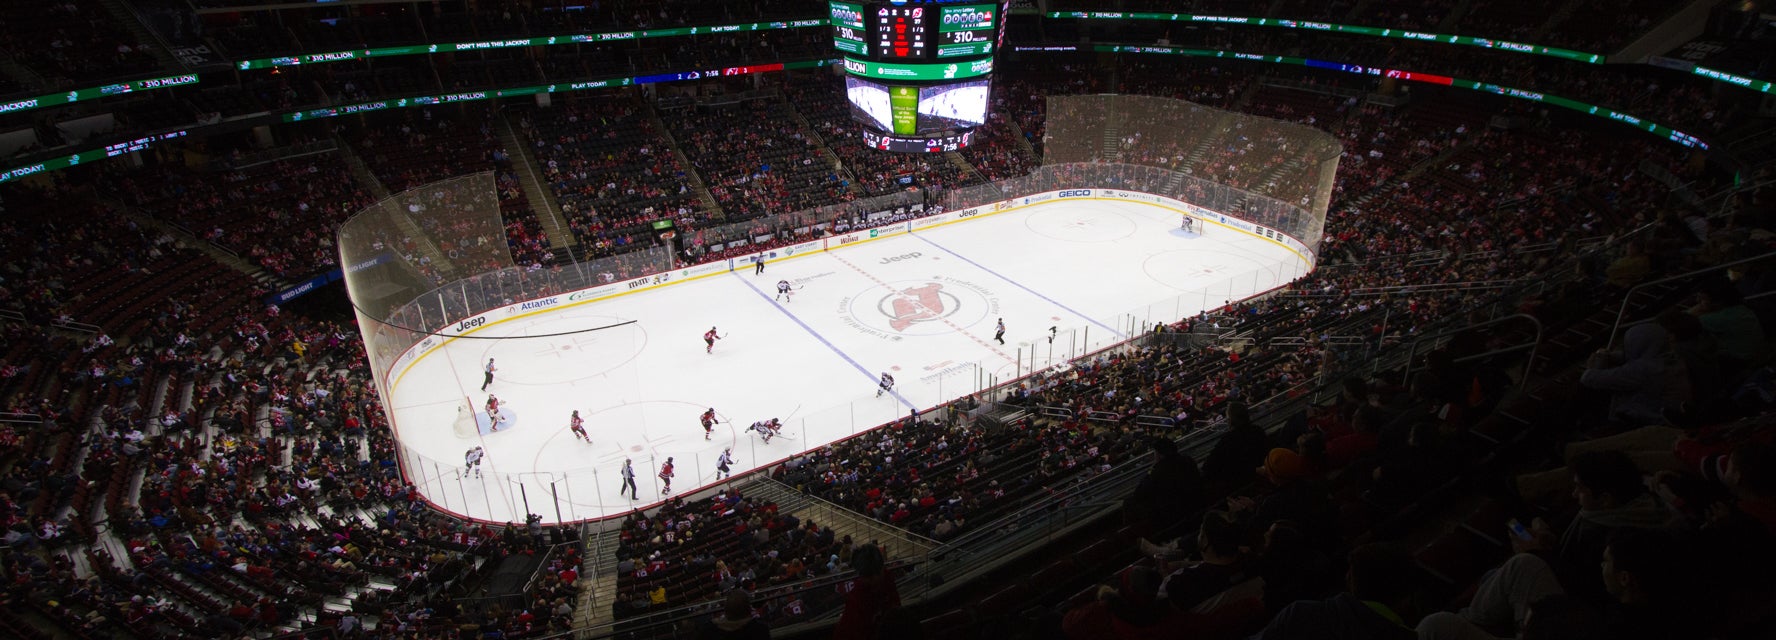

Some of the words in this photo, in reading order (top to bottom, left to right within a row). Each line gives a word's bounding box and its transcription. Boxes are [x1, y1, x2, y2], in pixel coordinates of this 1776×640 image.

[614, 32, 634, 40] MILLION
[954, 31, 973, 43] 310
[326, 52, 354, 61] MILLION
[144, 80, 160, 90] 310
[161, 76, 196, 88] MILLION
[458, 92, 486, 100] MILLION
[359, 102, 387, 112] MILLION
[943, 143, 957, 152] 7:56
[12, 164, 45, 178] TODAY!
[1059, 189, 1090, 198] GEICO
[960, 208, 978, 218] Jeep
[880, 252, 922, 264] Jeep
[358, 259, 378, 270] LIGHT
[281, 290, 298, 301] BUD
[296, 282, 314, 297] LIGHT
[522, 298, 558, 310] Atlantic
[456, 316, 486, 332] Jeep
